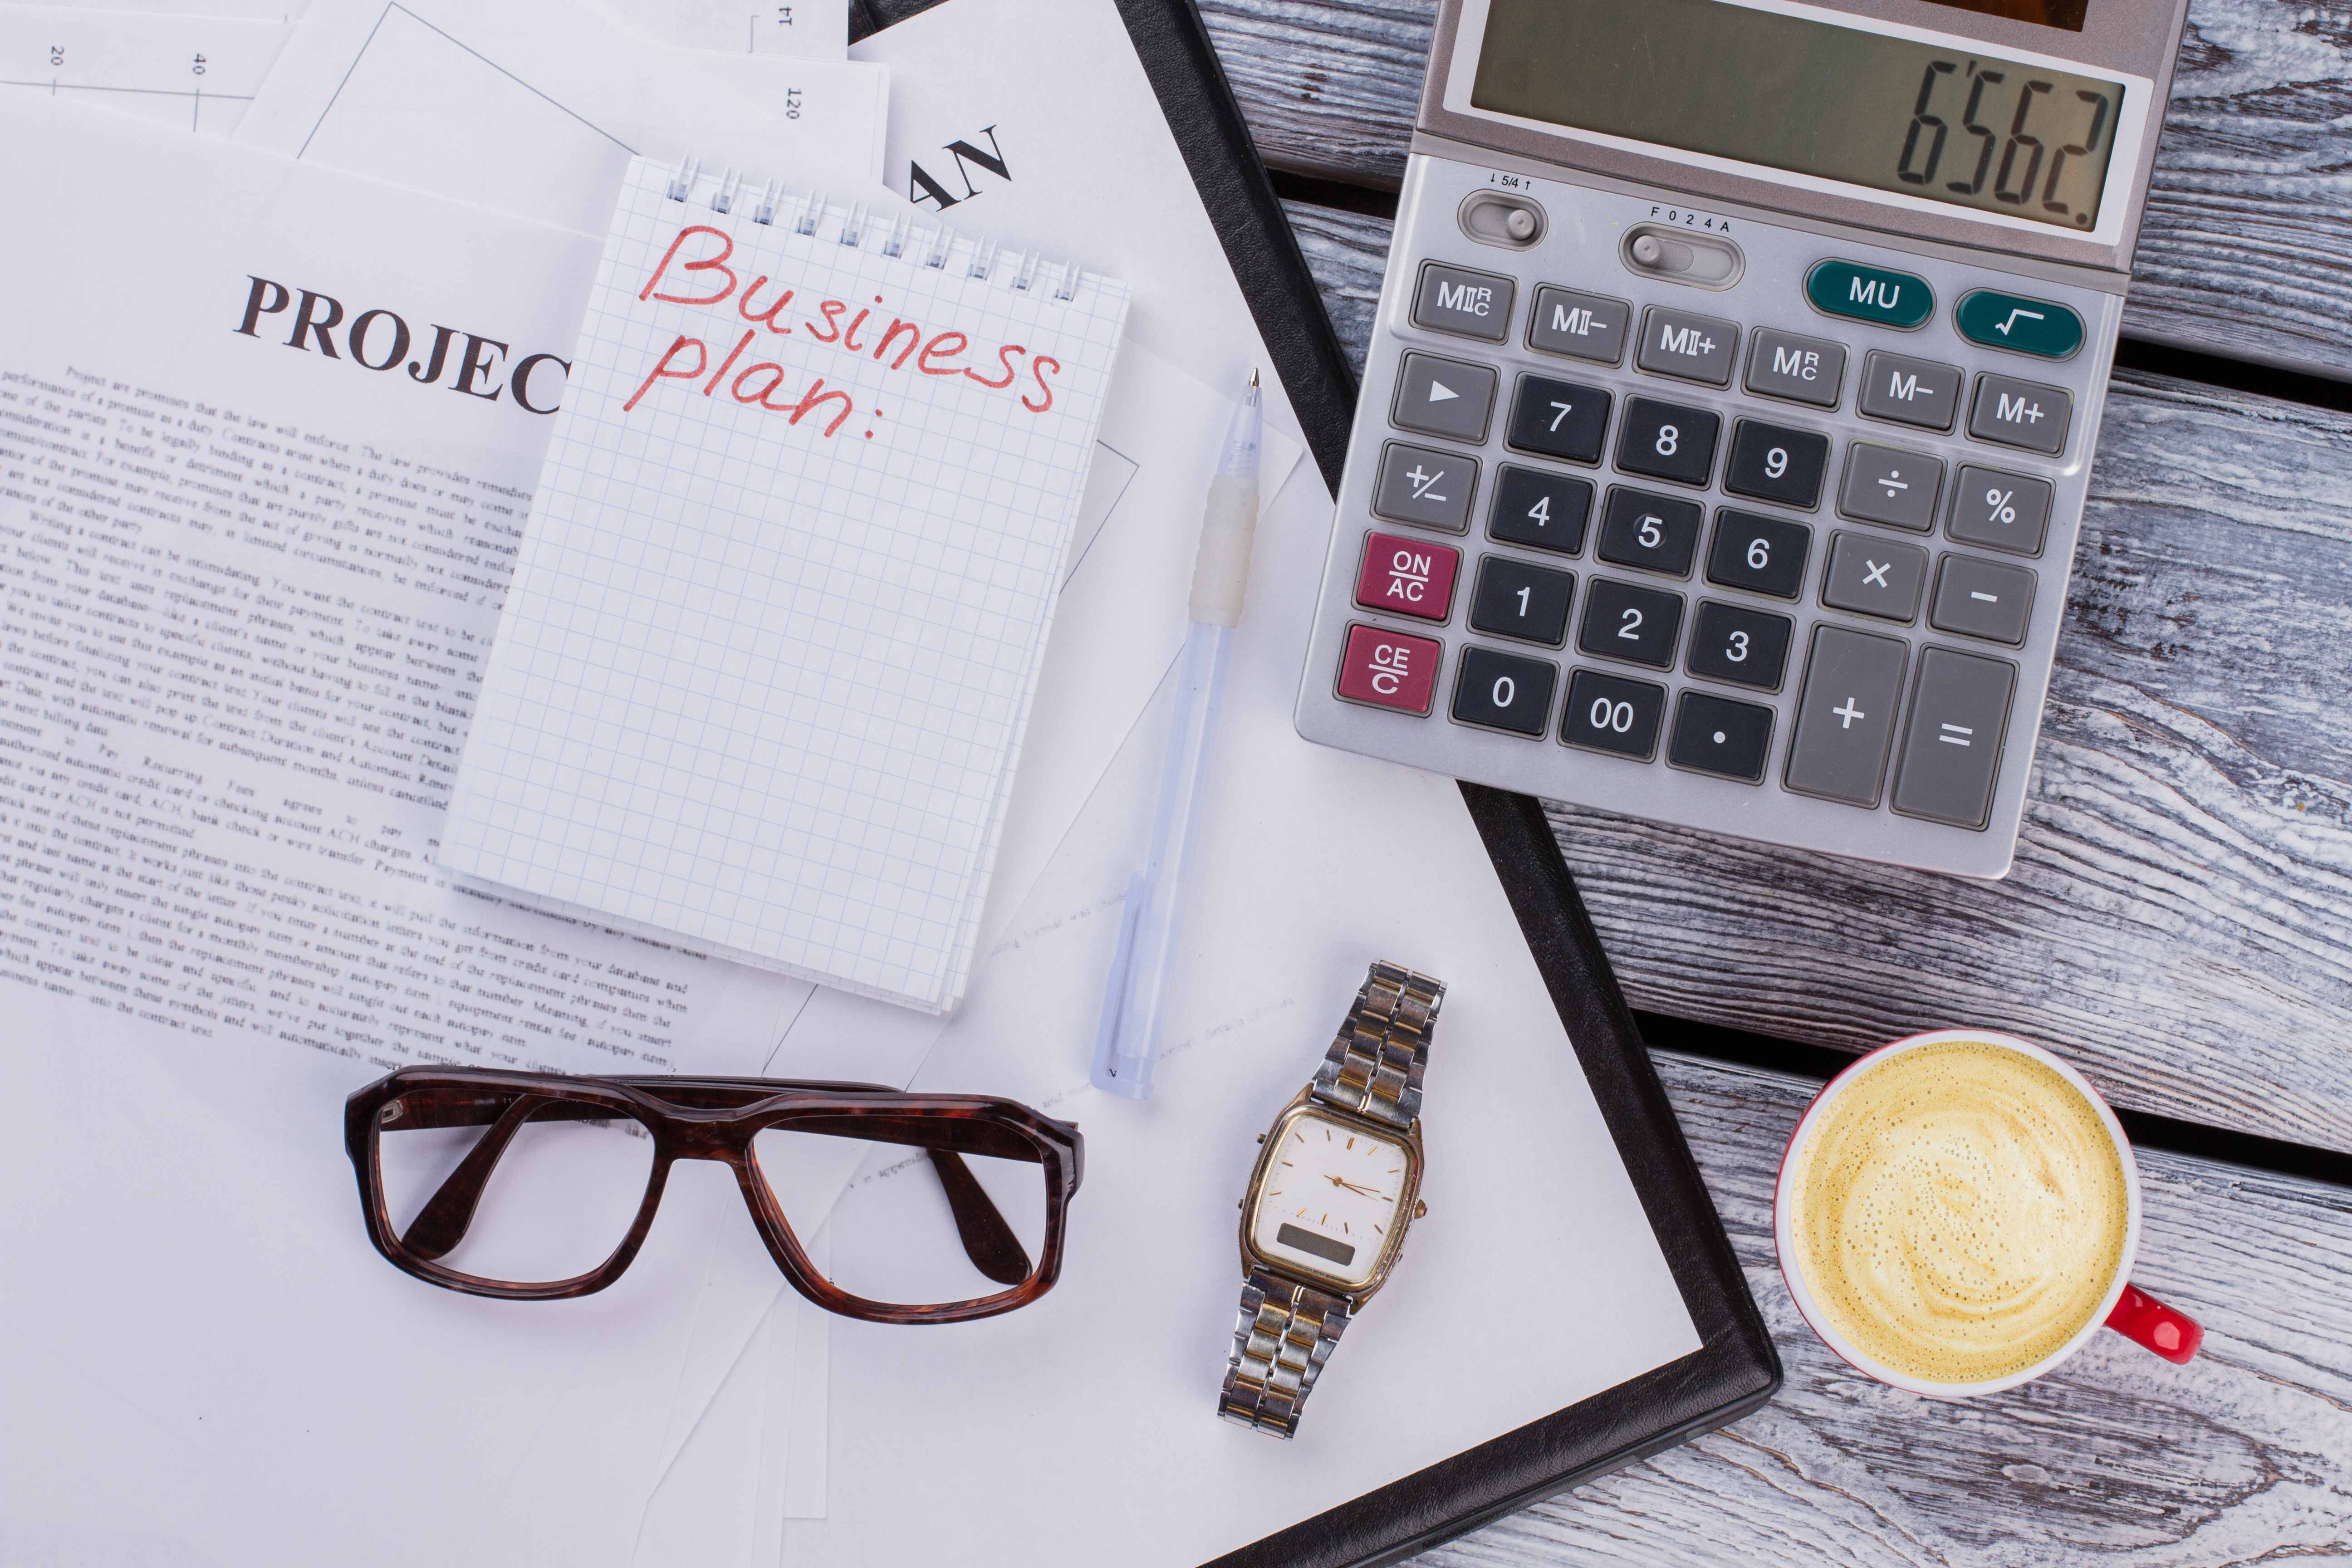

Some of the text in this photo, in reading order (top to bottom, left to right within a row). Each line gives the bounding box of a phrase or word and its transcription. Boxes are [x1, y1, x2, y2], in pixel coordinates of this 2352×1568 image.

[50, 46, 64, 66] 20
[192, 54, 206, 75] 40
[786, 88, 802, 119] 120
[1501, 175, 1519, 188] 5/4
[1651, 206, 1660, 217] F
[1686, 214, 1694, 225] 2
[1704, 218, 1712, 229] 4
[1720, 221, 1729, 233] A
[1849, 277, 1900, 309] MU
[640, 225, 1060, 412] Business
[1550, 402, 1572, 431] 7
[1996, 393, 2044, 423] M+
[1656, 425, 1678, 456] 8
[1765, 448, 1788, 478] 9
[1528, 496, 1549, 526] 4
[1986, 489, 2015, 524] %
[1639, 516, 1662, 547] 5
[1393, 551, 1431, 575] ON
[1748, 539, 1769, 568] 6
[1387, 578, 1424, 601] AC
[1517, 587, 1530, 616] 1
[1618, 609, 1642, 640] 2
[1375, 644, 1410, 669] CE
[1726, 631, 1749, 662] 3
[1372, 673, 1399, 694] C
[1493, 676, 1514, 707] 0
[1591, 698, 1633, 732] 00
